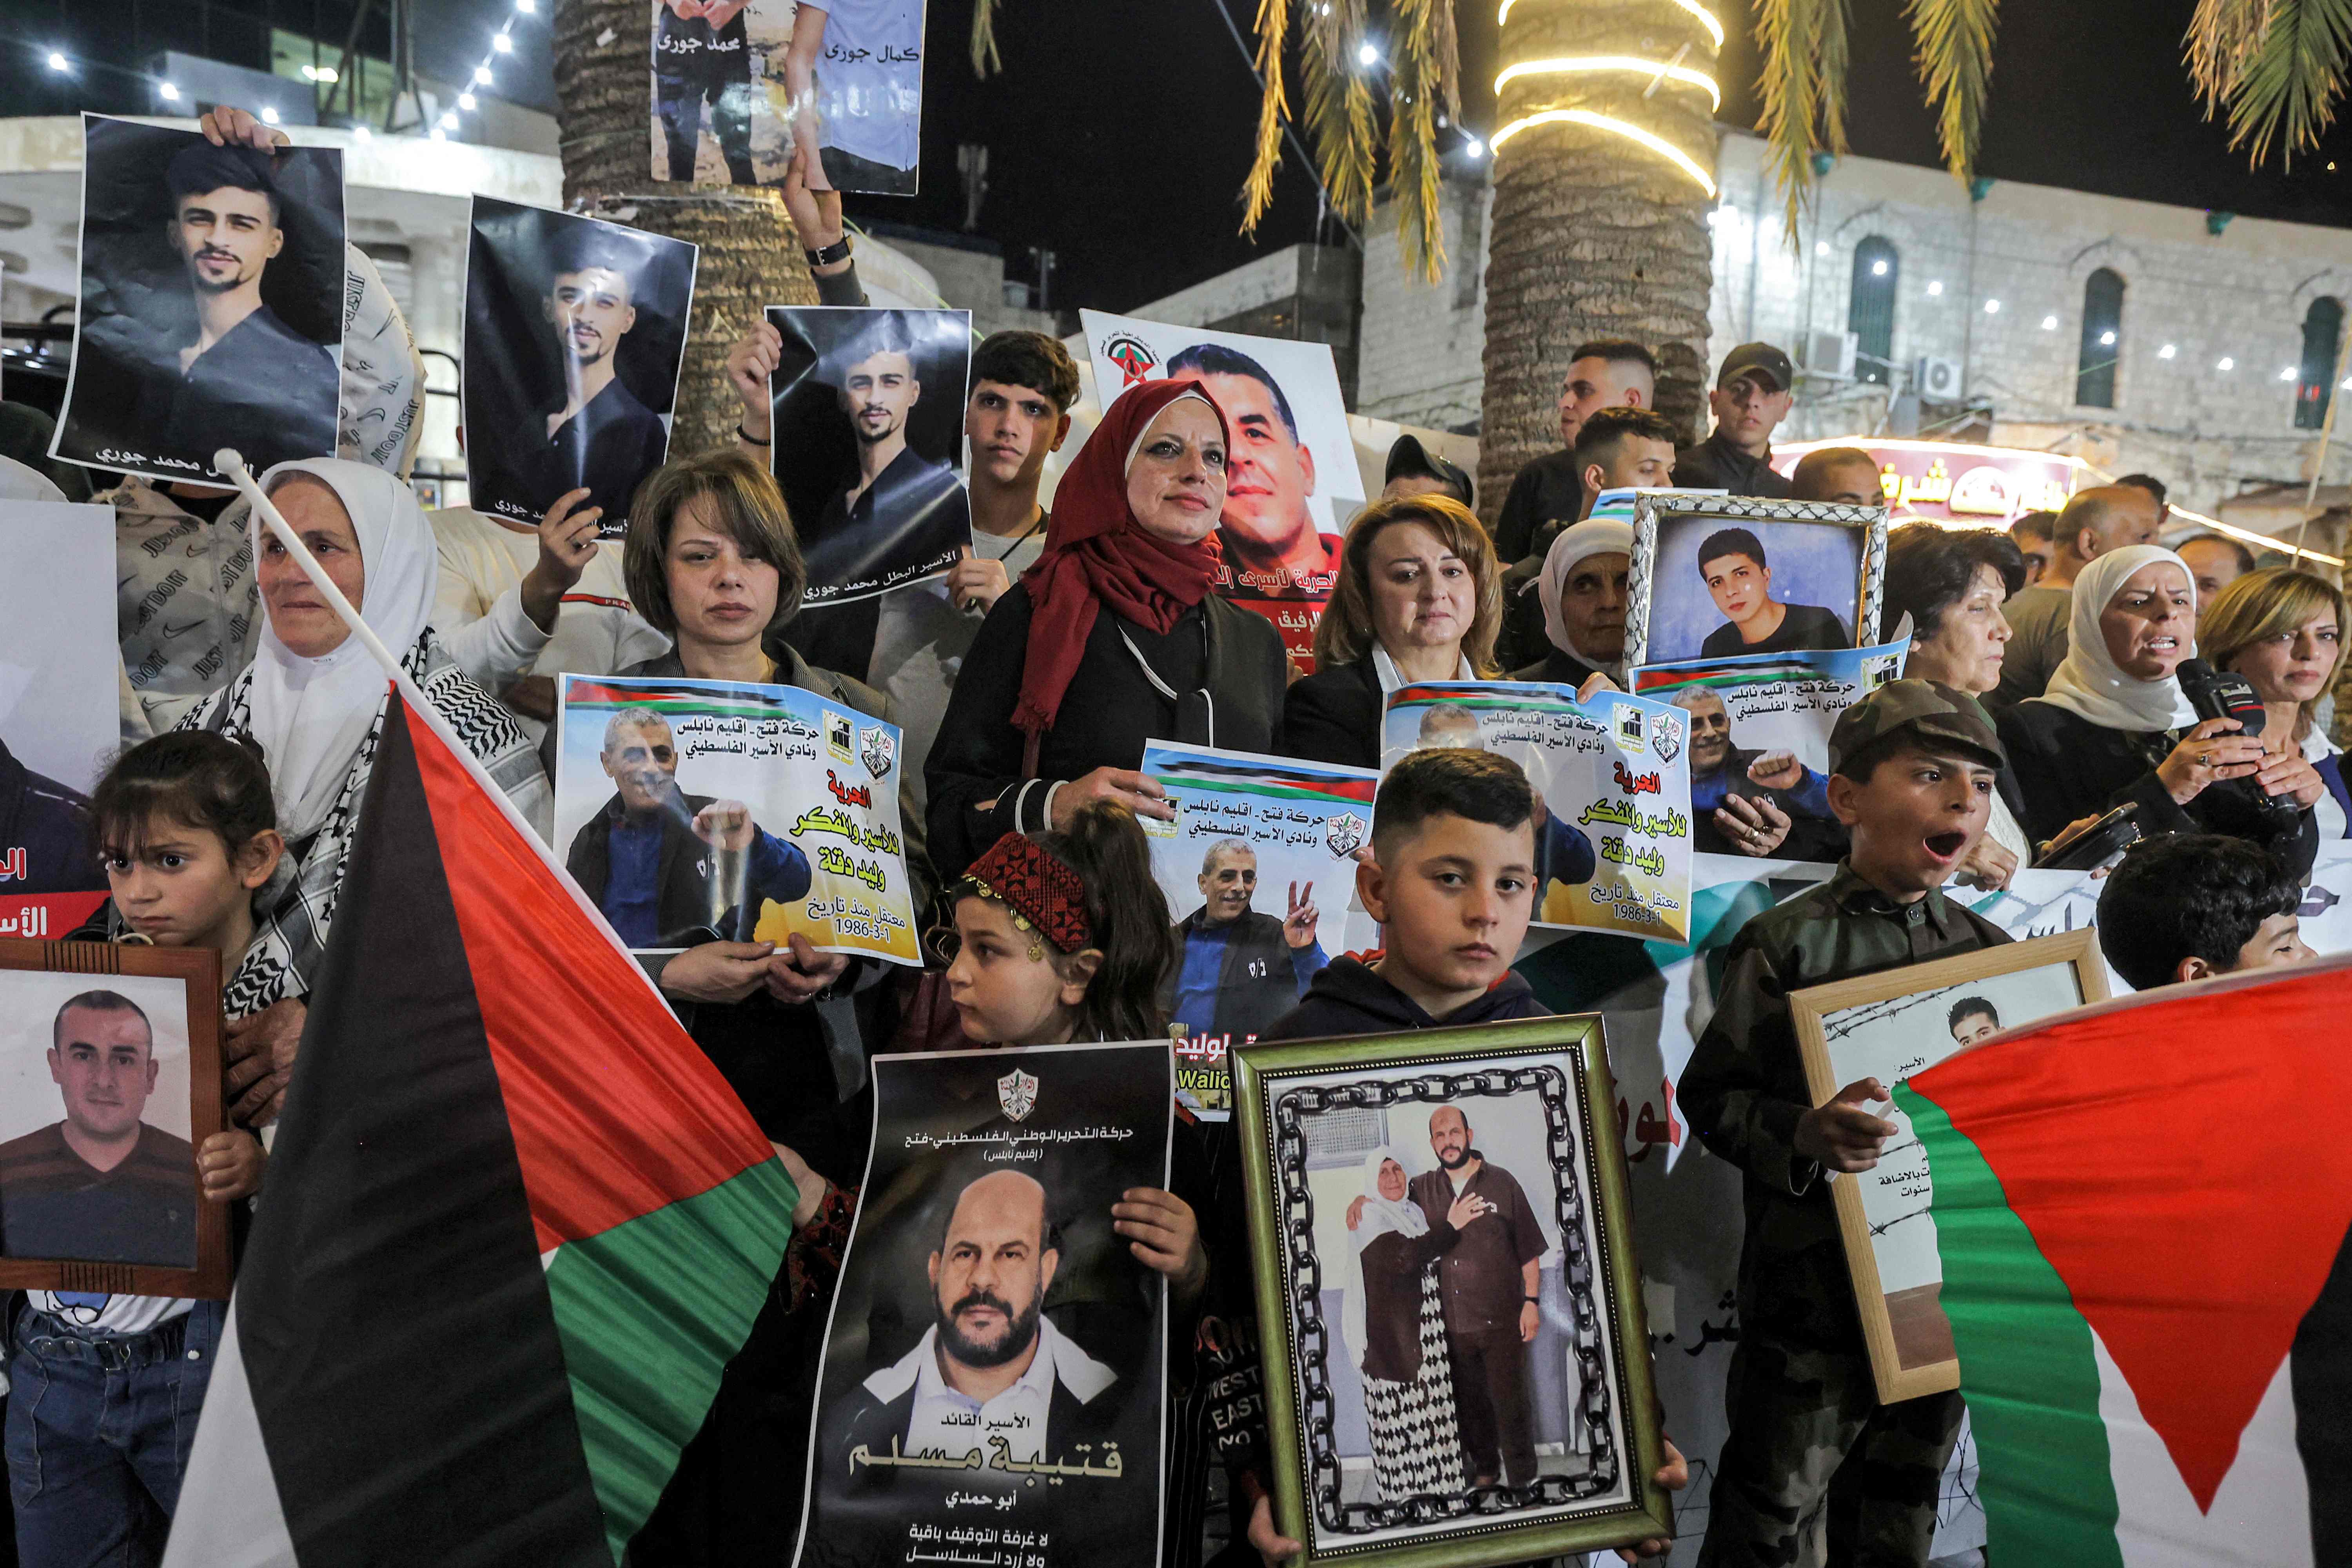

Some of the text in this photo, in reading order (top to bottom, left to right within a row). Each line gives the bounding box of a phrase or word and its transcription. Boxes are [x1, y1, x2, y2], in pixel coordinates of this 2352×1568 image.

[95, 448, 147, 466] جوري
[153, 455, 200, 470] محمد
[494, 499, 528, 517] جوري
[844, 579, 878, 592] محمد
[883, 565, 915, 586] البطل
[803, 584, 839, 601] جوري
[605, 598, 629, 609] PRA
[1278, 610, 1320, 632] الرفيق
[1727, 686, 1758, 703] نابلس
[1818, 681, 1856, 695] حركة
[1736, 700, 1788, 722] الفلسطيني
[1791, 696, 1820, 713] الأسير
[677, 717, 713, 735] نابلس
[1482, 712, 1515, 726] نابلس
[1575, 717, 1608, 735] حركة
[782, 720, 820, 740] حركة
[686, 739, 817, 760] ونادي الأسير الفلسطيني
[1490, 730, 1605, 755] ونادي الأسير الفلسطيني
[1613, 760, 1661, 795] الحرية
[826, 768, 872, 810] الحرية
[1183, 799, 1220, 816] نابلس
[1286, 808, 1325, 828] حركة
[1577, 798, 1644, 834] والمفكر
[789, 806, 860, 846] والمفكر
[1189, 820, 1318, 848] ونادي الأسير الفلسطيني
[1601, 835, 1665, 877] وليد دقة
[817, 846, 886, 893] وليد دقة
[1590, 883, 1679, 909] معتقل منذ تاريخ
[808, 896, 906, 928] معتقل منذ تاريخ
[1613, 904, 1661, 925] 1986-3-1
[835, 918, 890, 942] 1986-3-1
[1009, 1129, 1057, 1147] الوطني
[1056, 1127, 1098, 1143] التحرير
[1099, 1126, 1134, 1142] حركة
[941, 1412, 1030, 1432] الأسير القائد
[1211, 1393, 1263, 1430] EAST
[848, 1433, 1123, 1488] قتيبة مسلم
[945, 1489, 1017, 1512] أبو حمدي
[909, 1523, 1049, 1550] لا غرفة التوقيف باقية
[905, 1545, 1002, 1566] السلاسل
[1026, 1553, 1045, 1568] ولا
